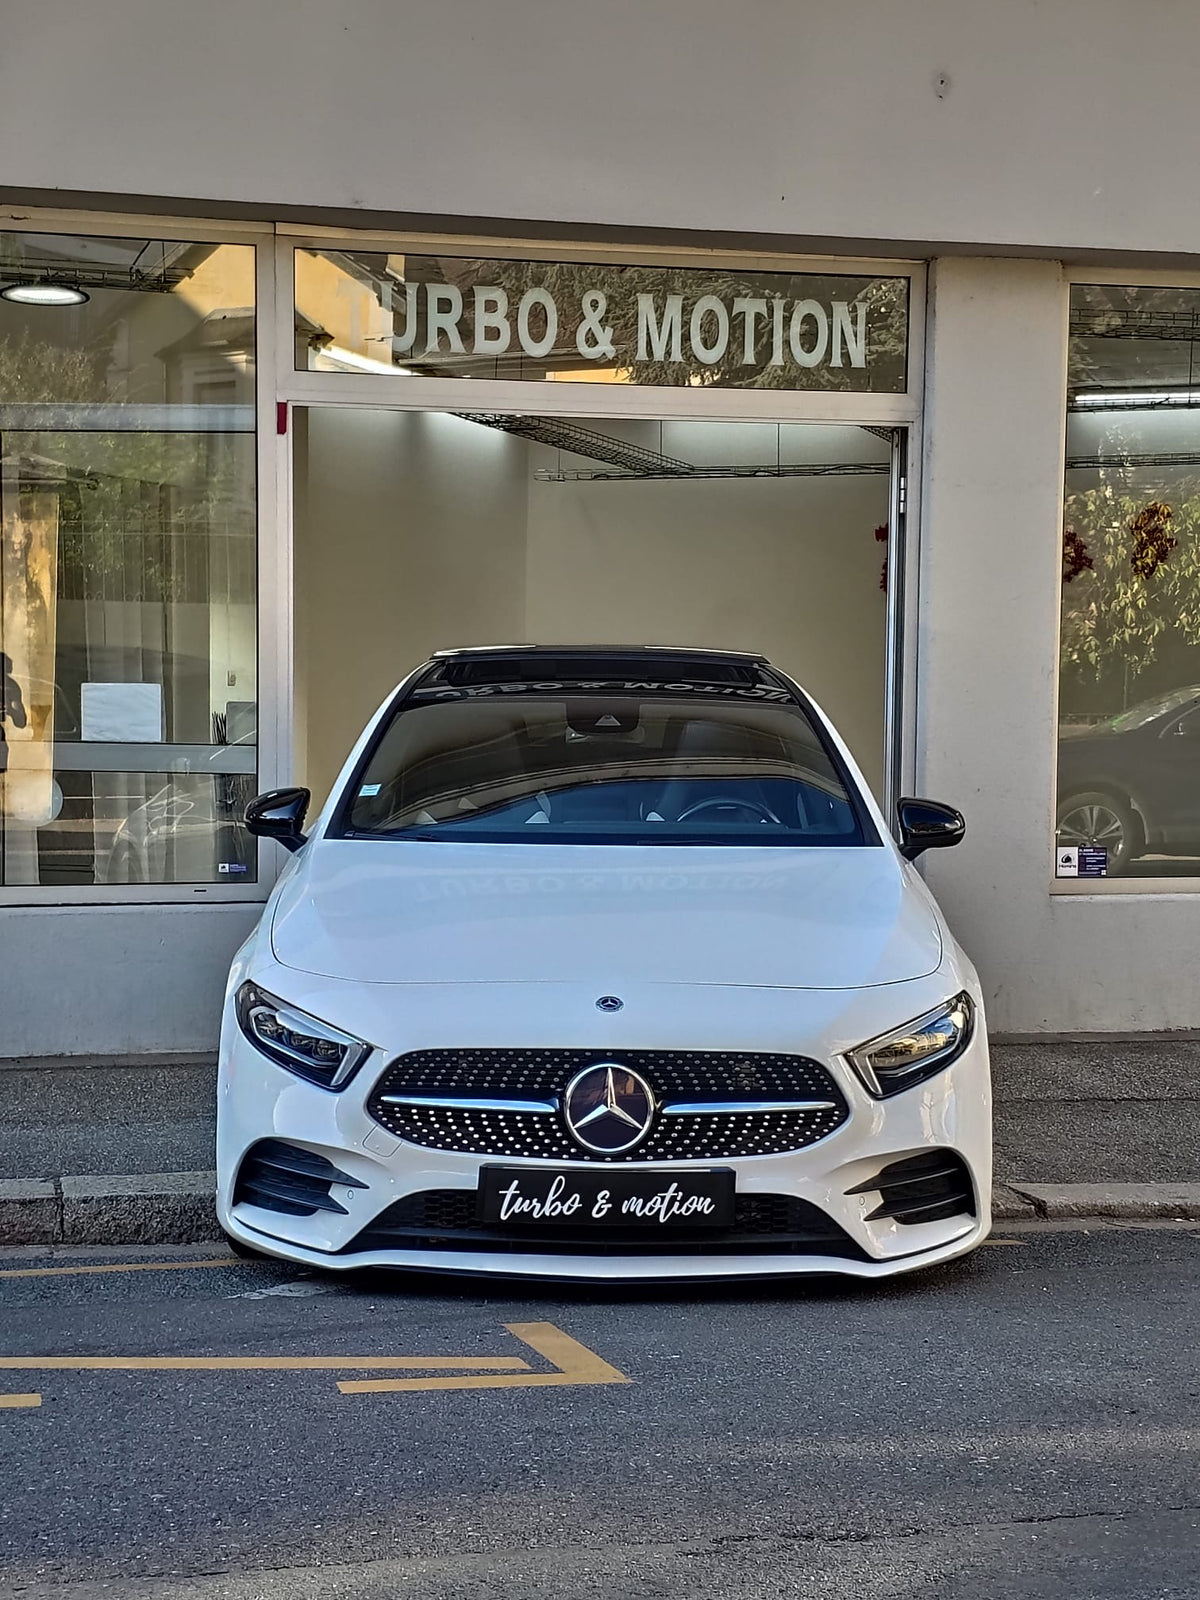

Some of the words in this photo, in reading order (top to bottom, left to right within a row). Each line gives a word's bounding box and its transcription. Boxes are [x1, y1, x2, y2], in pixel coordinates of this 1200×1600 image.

[337, 279, 557, 358] TURBO
[575, 289, 616, 361] &
[635, 293, 867, 368] MOTION
[499, 1175, 582, 1221] turbo
[591, 1189, 612, 1218] &
[621, 1182, 715, 1223] motion
